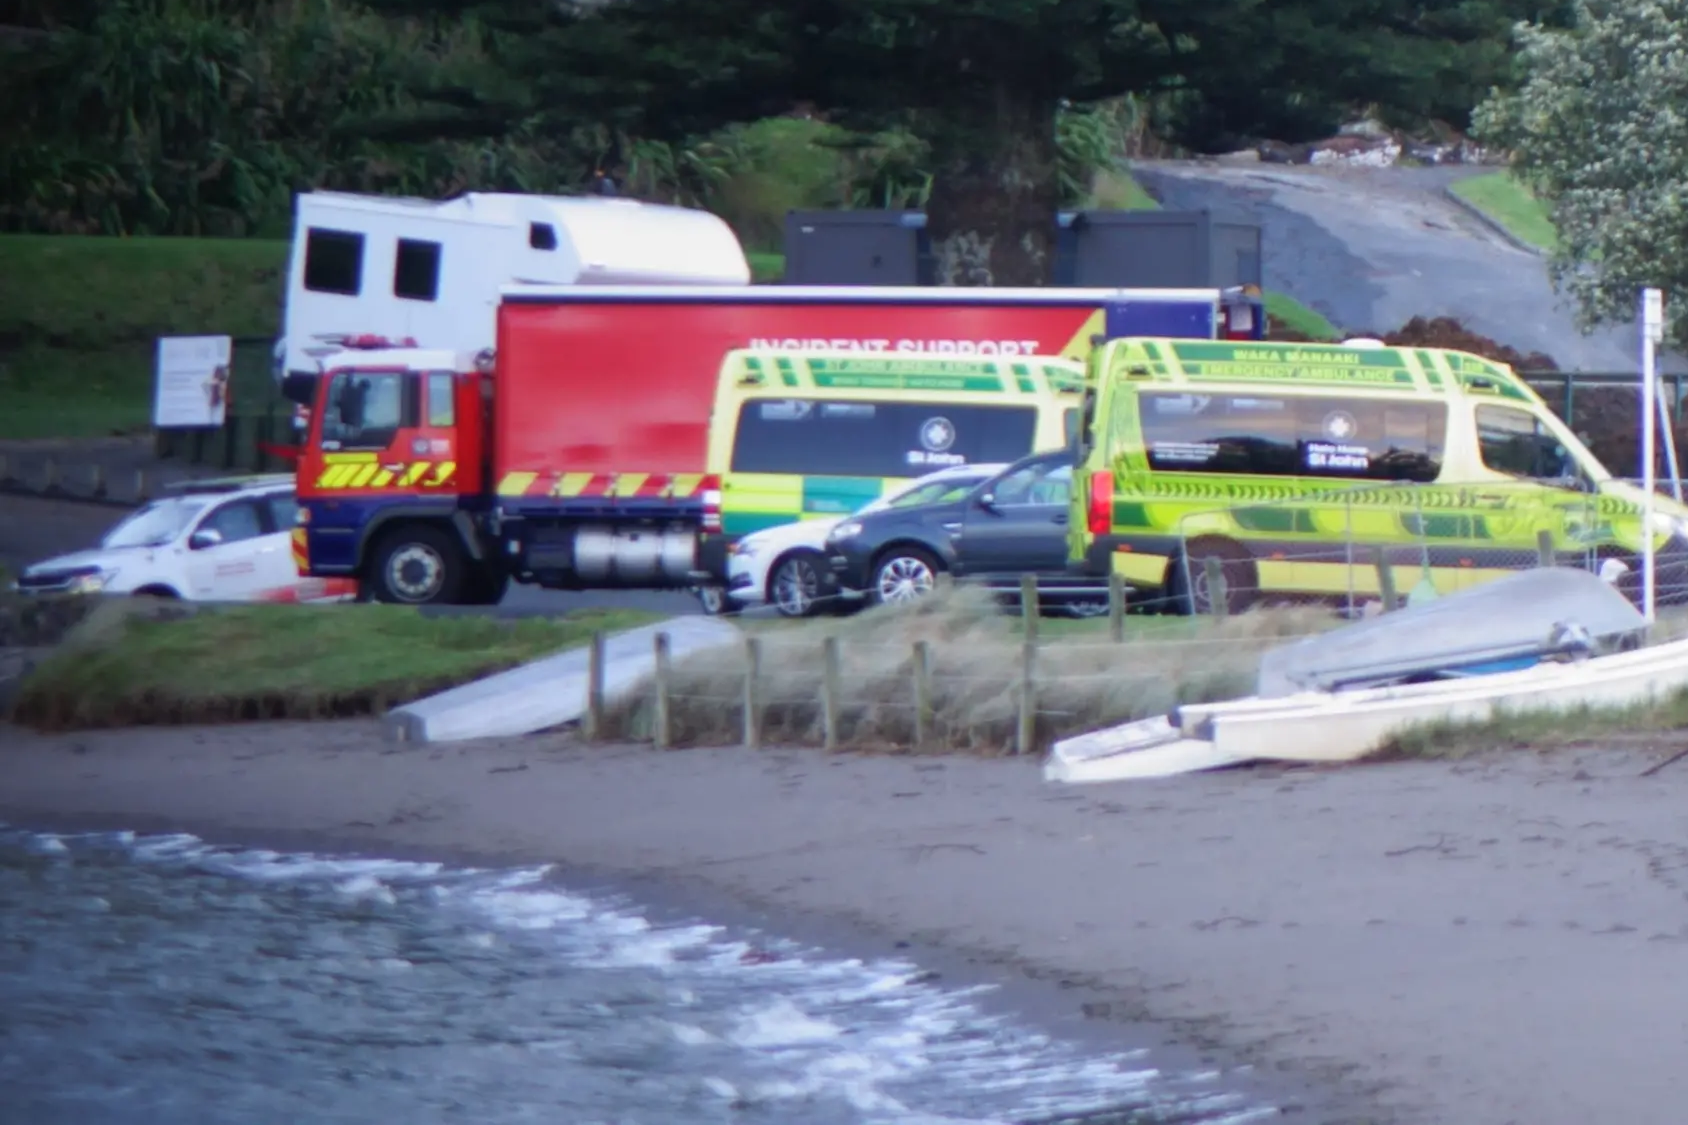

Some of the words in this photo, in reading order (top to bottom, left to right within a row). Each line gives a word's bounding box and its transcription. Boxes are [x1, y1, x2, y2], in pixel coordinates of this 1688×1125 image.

[749, 338, 888, 353] INCIDENT
[896, 340, 1039, 355] SUPPORT
[1233, 349, 1280, 362] WAKA
[1286, 349, 1360, 364] MANAAKI
[1200, 364, 1294, 379] EMERGENCY
[1299, 365, 1396, 382] AMBULANCE
[907, 451, 924, 463] St
[926, 451, 964, 465] John
[1308, 454, 1325, 467] St
[1327, 454, 1369, 469] John
